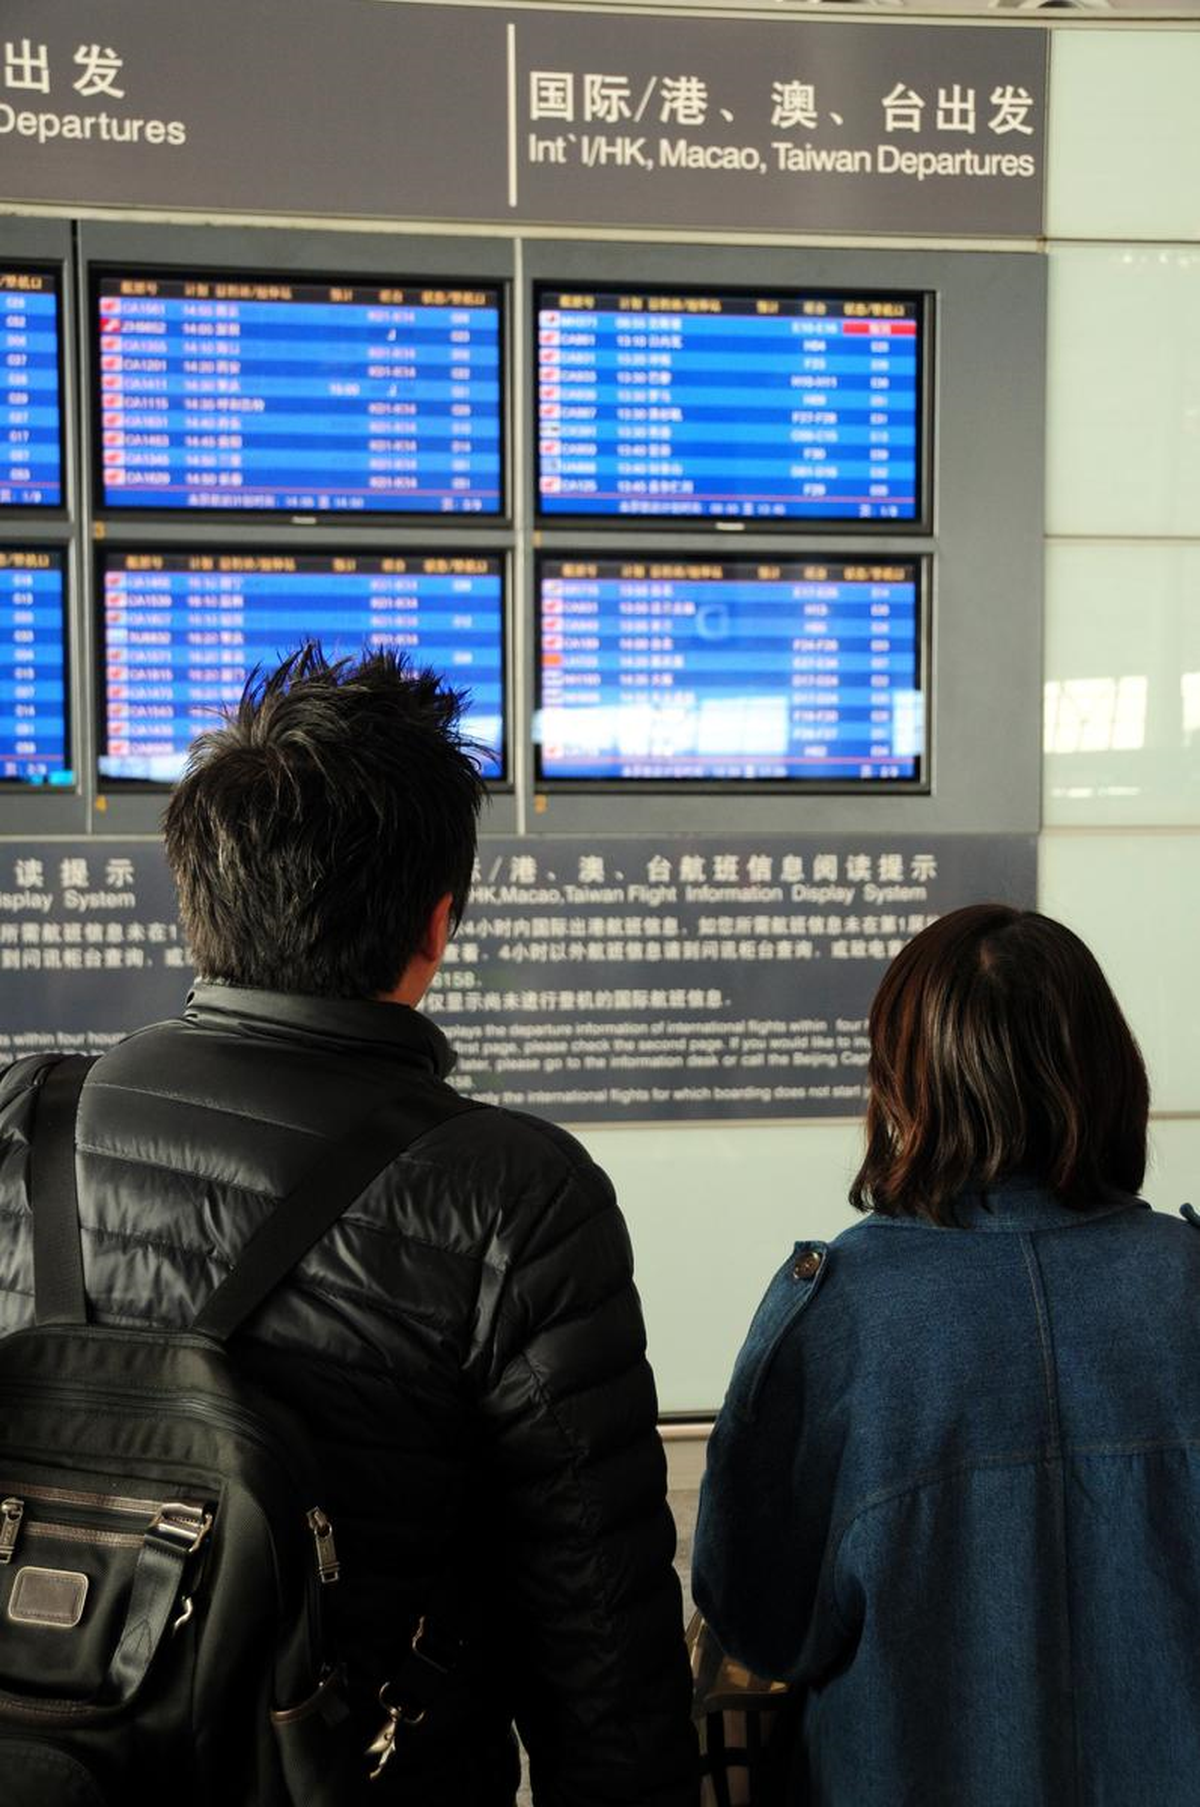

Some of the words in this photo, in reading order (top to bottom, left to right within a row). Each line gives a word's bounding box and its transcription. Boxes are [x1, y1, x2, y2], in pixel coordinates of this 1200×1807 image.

[4, 39, 126, 99] 出发
[0, 105, 187, 145] Departures
[659, 138, 767, 174] Macao,
[771, 141, 872, 173] Taiwan
[877, 144, 1035, 181] Departures
[63, 889, 136, 913] System
[627, 883, 678, 907] Flight
[685, 884, 784, 904] Information
[791, 884, 856, 906] Display
[862, 883, 928, 906] System
[575, 1022, 648, 1035] information
